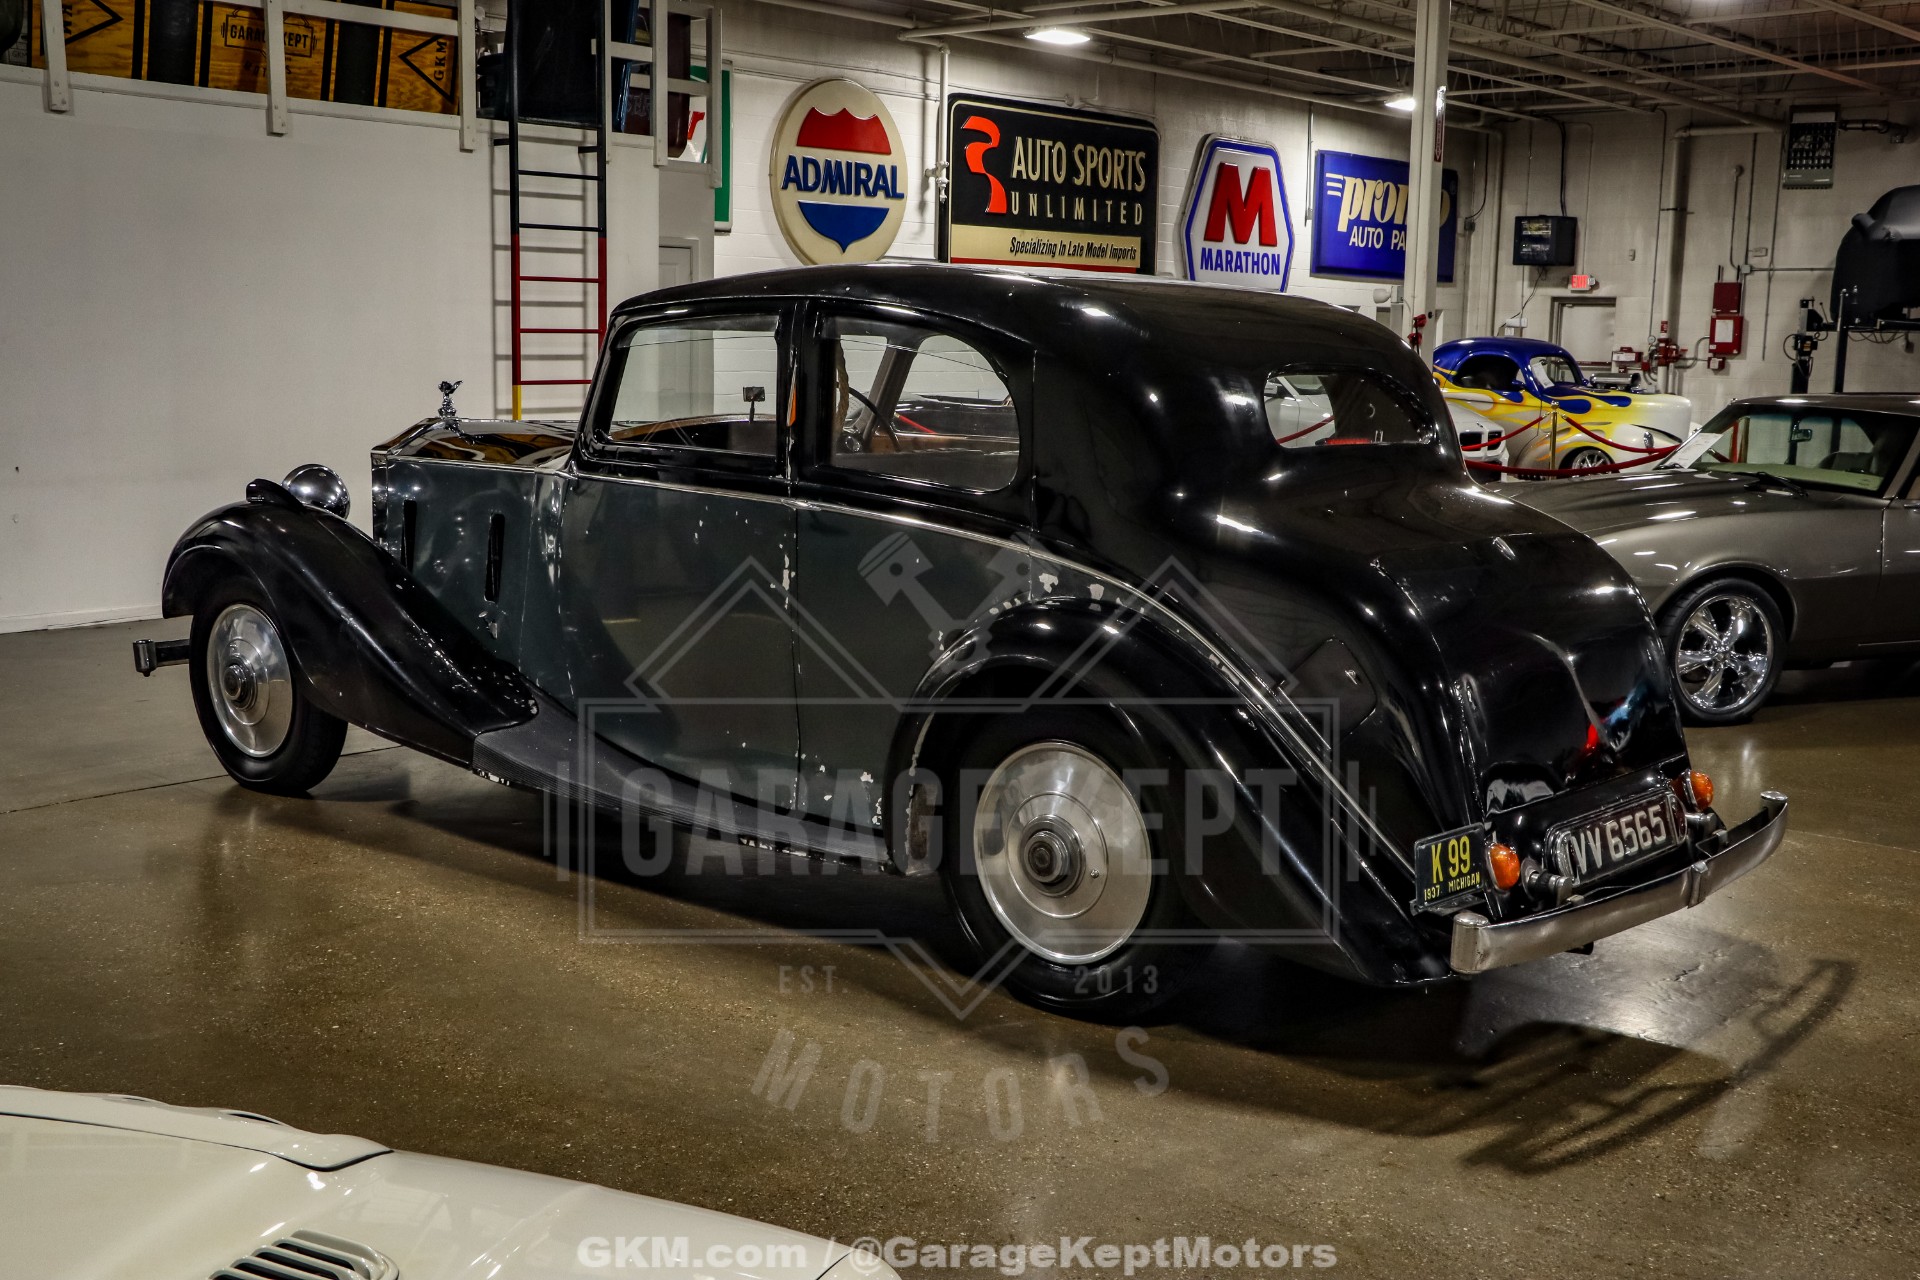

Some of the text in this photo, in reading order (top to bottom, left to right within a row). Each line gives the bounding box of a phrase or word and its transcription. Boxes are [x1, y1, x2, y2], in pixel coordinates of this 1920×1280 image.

[229, 24, 266, 44] GARA
[434, 40, 448, 81] GKM
[781, 154, 905, 200] ADMIRAL
[1011, 136, 1146, 193] AUTO SPORTS
[1011, 190, 1143, 226] UNLIMITED
[1009, 236, 1137, 262] Specializing In Late Model Imports
[1349, 225, 1384, 249] AUTO
[1200, 246, 1281, 276] MARATHON
[1431, 835, 1471, 884] K 99
[1423, 871, 1480, 901] 1937 MICHIGAN
